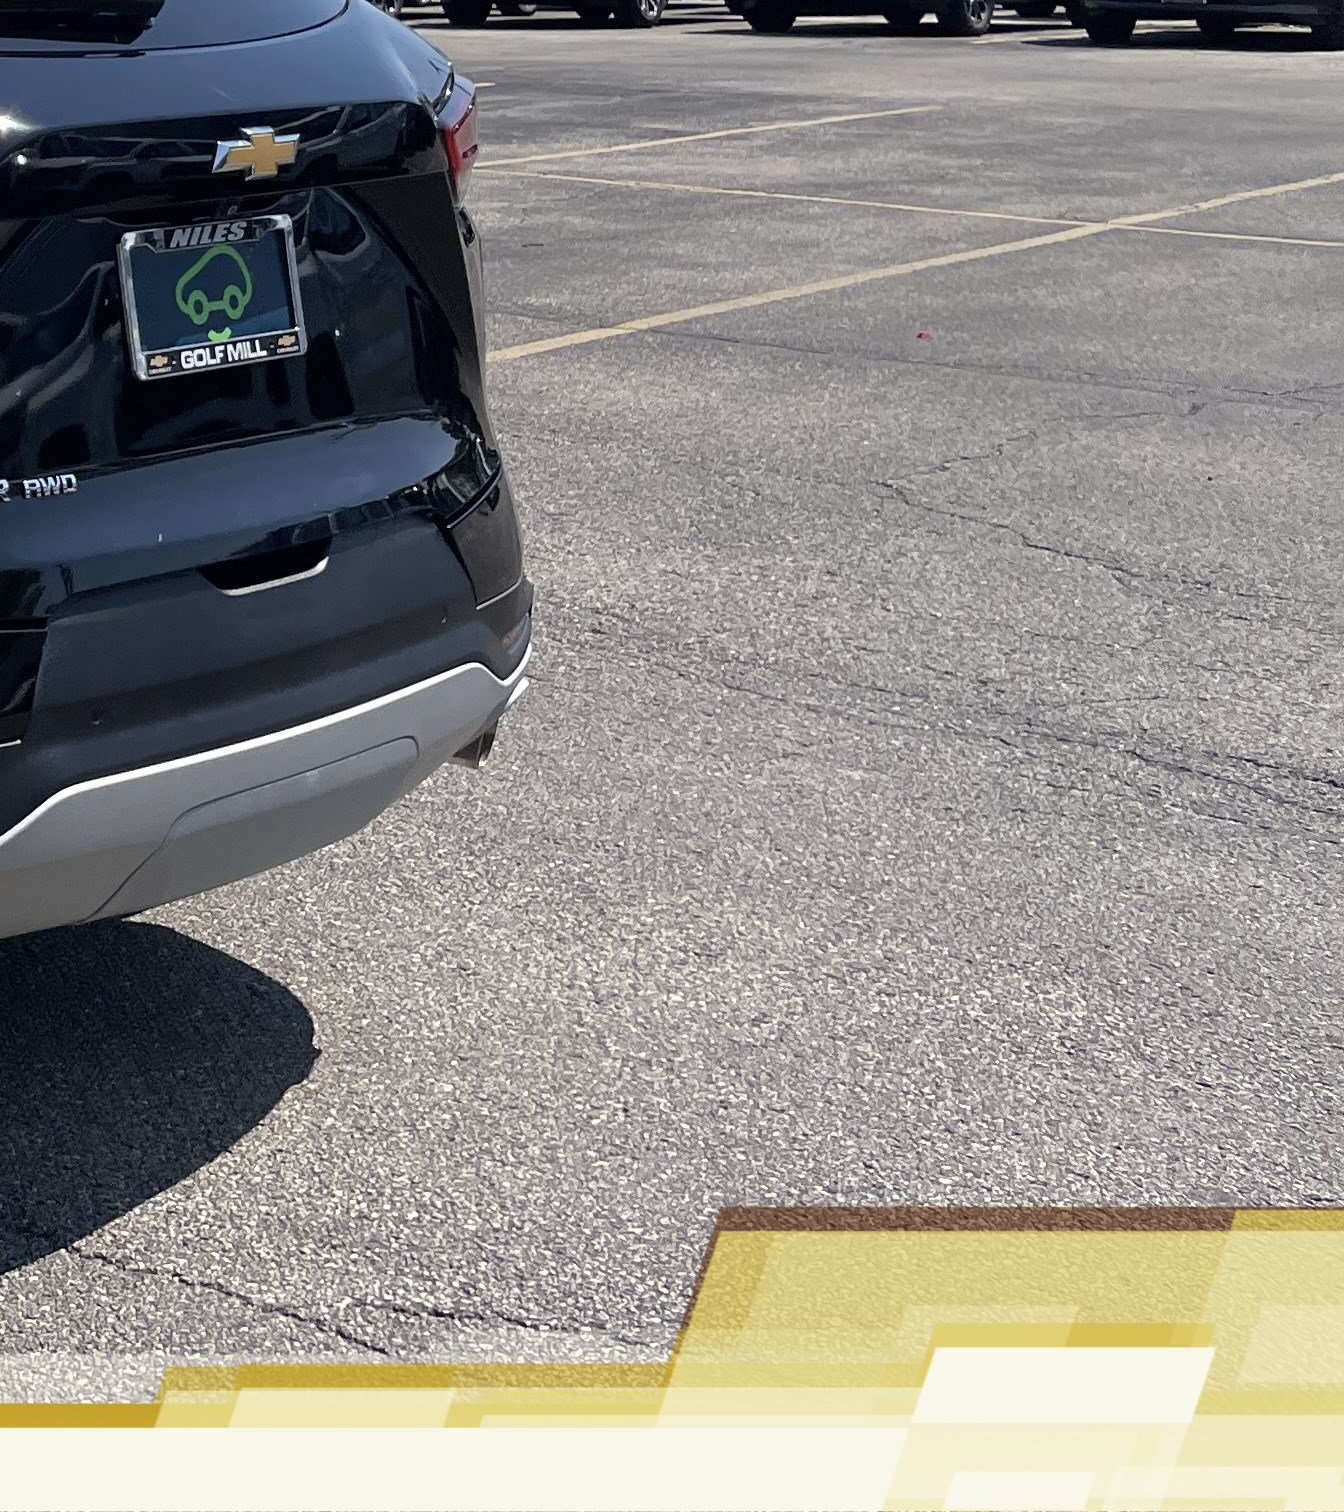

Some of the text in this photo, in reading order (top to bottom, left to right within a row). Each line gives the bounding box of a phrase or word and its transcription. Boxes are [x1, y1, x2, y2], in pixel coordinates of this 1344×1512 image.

[169, 220, 247, 249] NILES
[180, 345, 227, 370] GOLF
[226, 338, 268, 363] MILL
